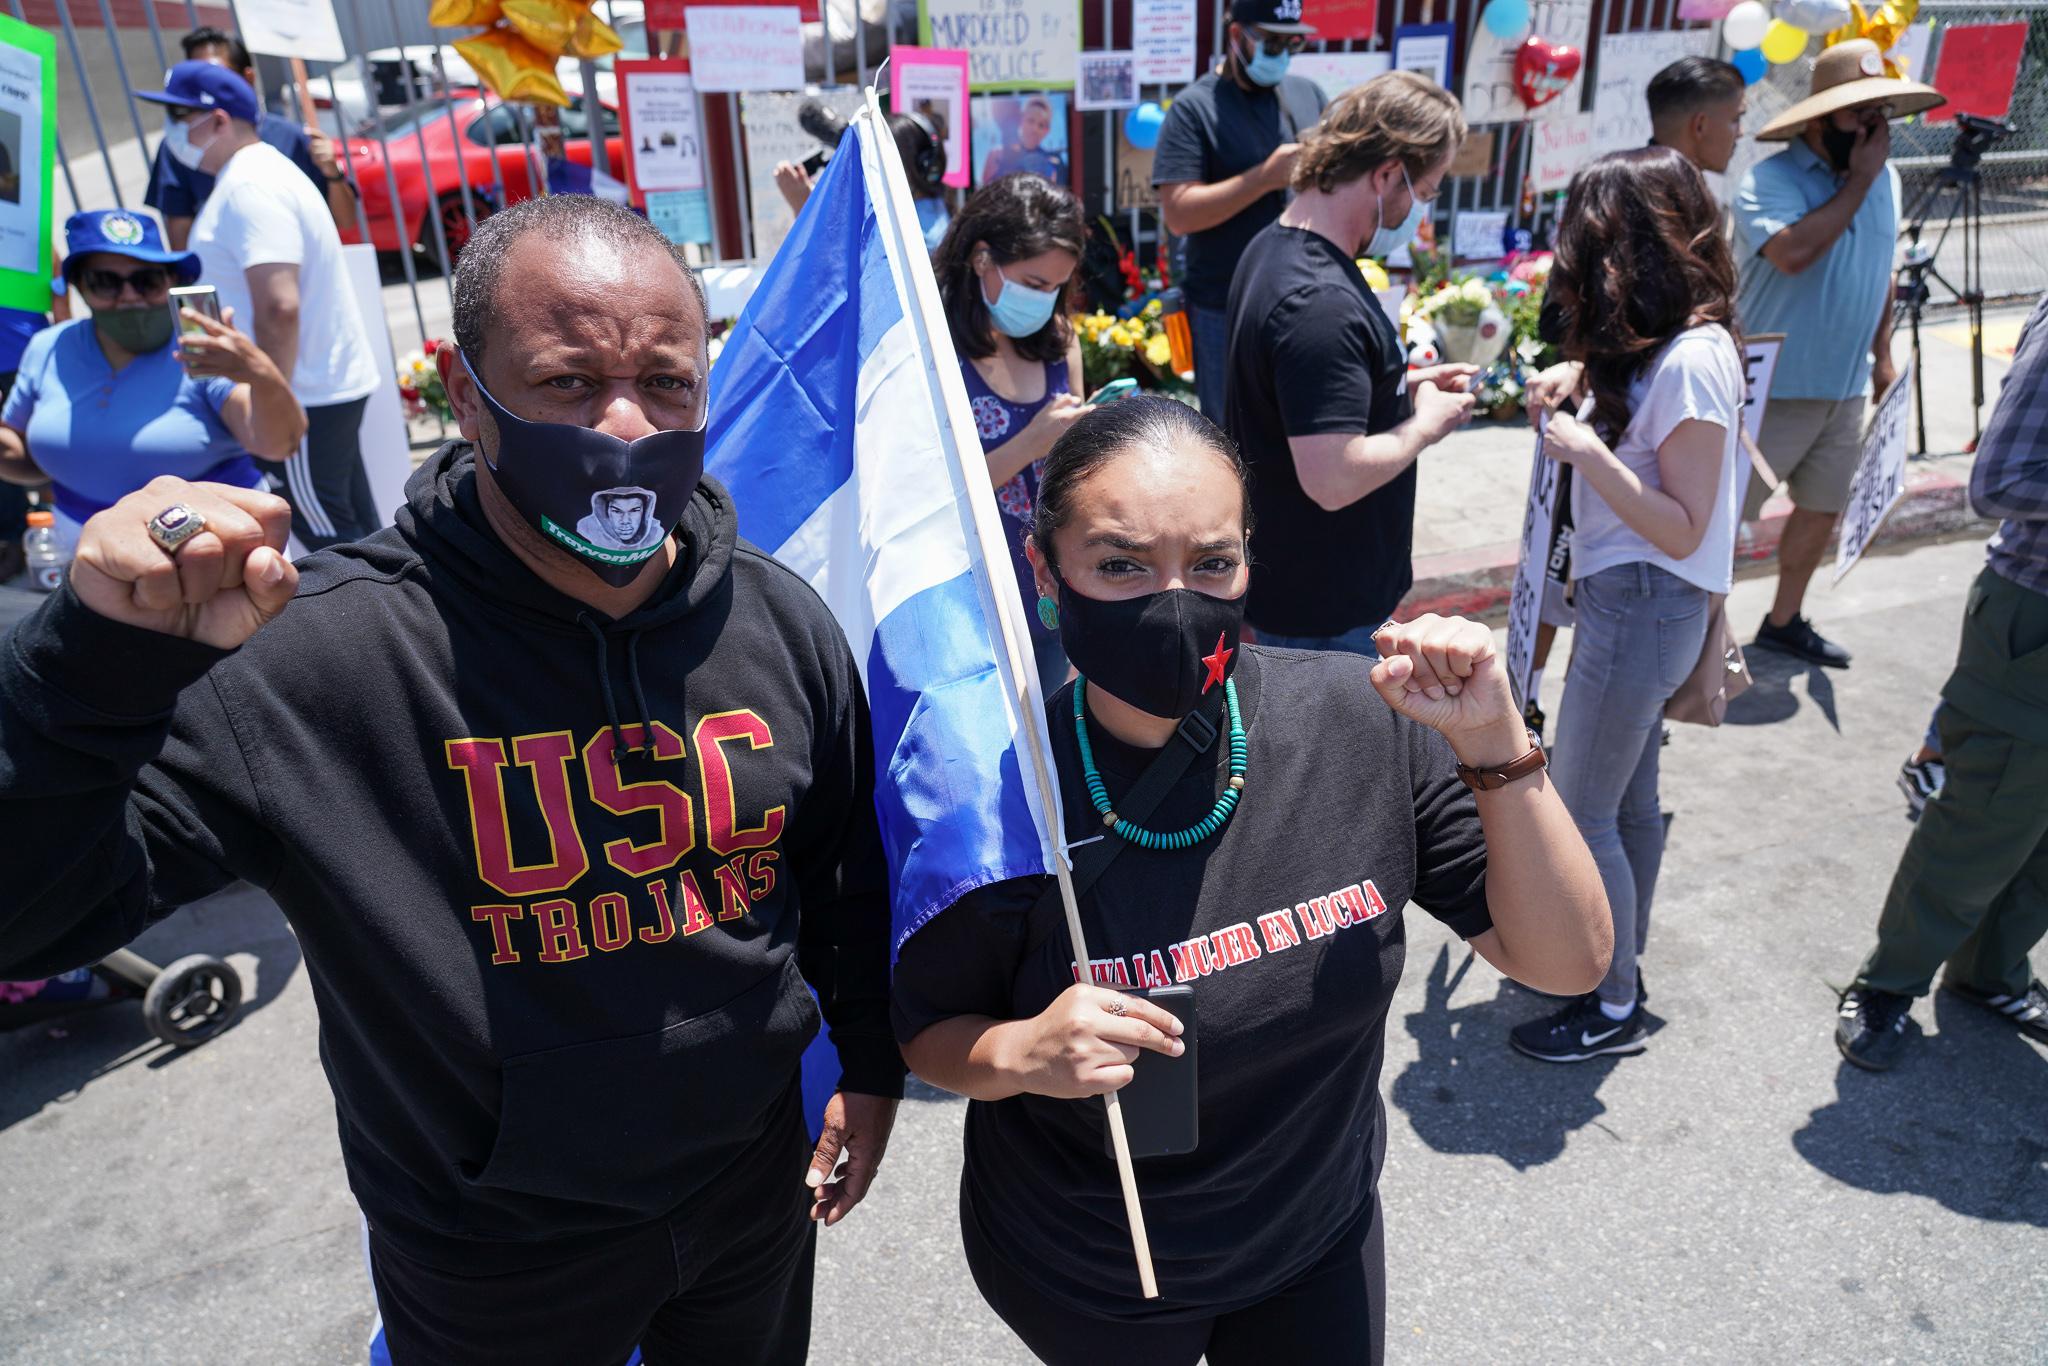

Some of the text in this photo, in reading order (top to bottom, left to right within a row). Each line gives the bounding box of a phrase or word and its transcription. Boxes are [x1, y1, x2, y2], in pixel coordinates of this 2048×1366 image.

[930, 11, 1030, 48] MURDERED
[969, 50, 1050, 81] POLICE
[444, 708, 786, 897] USC
[471, 850, 780, 965] TROJANS
[1131, 949, 1172, 988] LA
[1168, 922, 1261, 983] MUJER
[1256, 908, 1302, 953] EN
[1295, 879, 1387, 941] LUCHA
